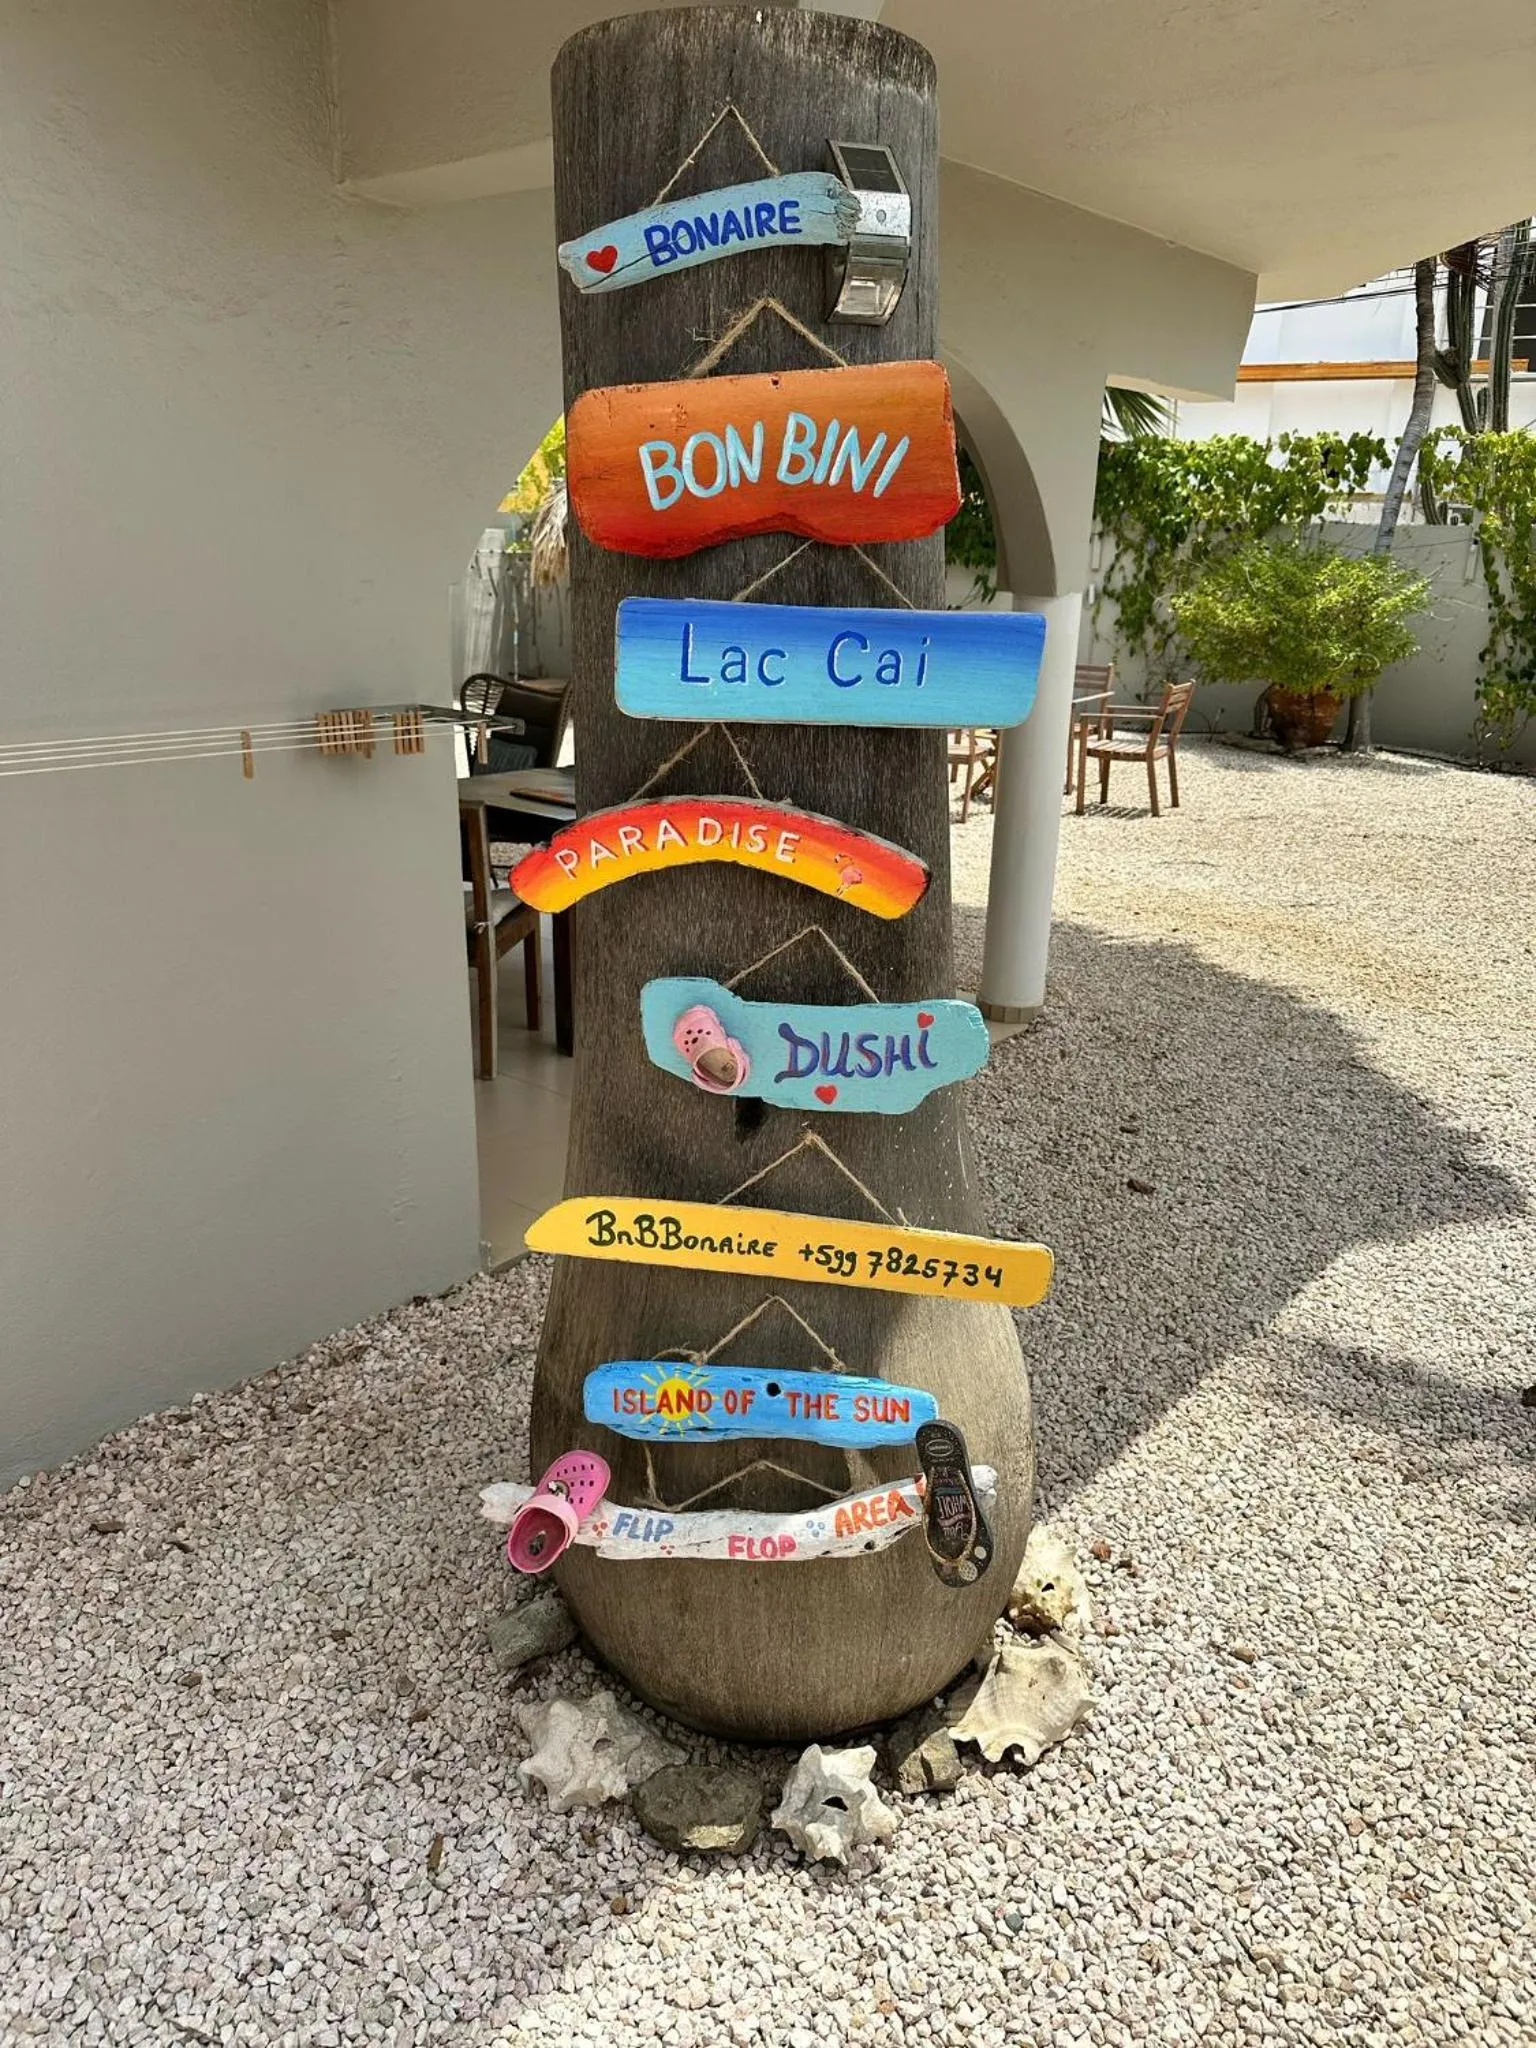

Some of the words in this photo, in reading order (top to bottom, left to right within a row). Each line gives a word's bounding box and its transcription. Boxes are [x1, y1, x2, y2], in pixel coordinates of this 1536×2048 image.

[644, 200, 803, 267] BONAIRE
[638, 420, 764, 511] BON
[776, 411, 910, 498] BINI
[680, 622, 789, 687] Lac
[827, 630, 931, 688] Cai
[554, 817, 802, 880] PARADISE
[798, 1244, 858, 1277] +599
[866, 1247, 1003, 1288] 7825734
[613, 1388, 713, 1416] ISLAND
[723, 1389, 756, 1415] OF
[785, 1391, 838, 1421] THE
[852, 1396, 912, 1423] SUN
[612, 1513, 675, 1542] FLIP
[728, 1534, 798, 1559] FLOP
[833, 1489, 914, 1537] AREA
